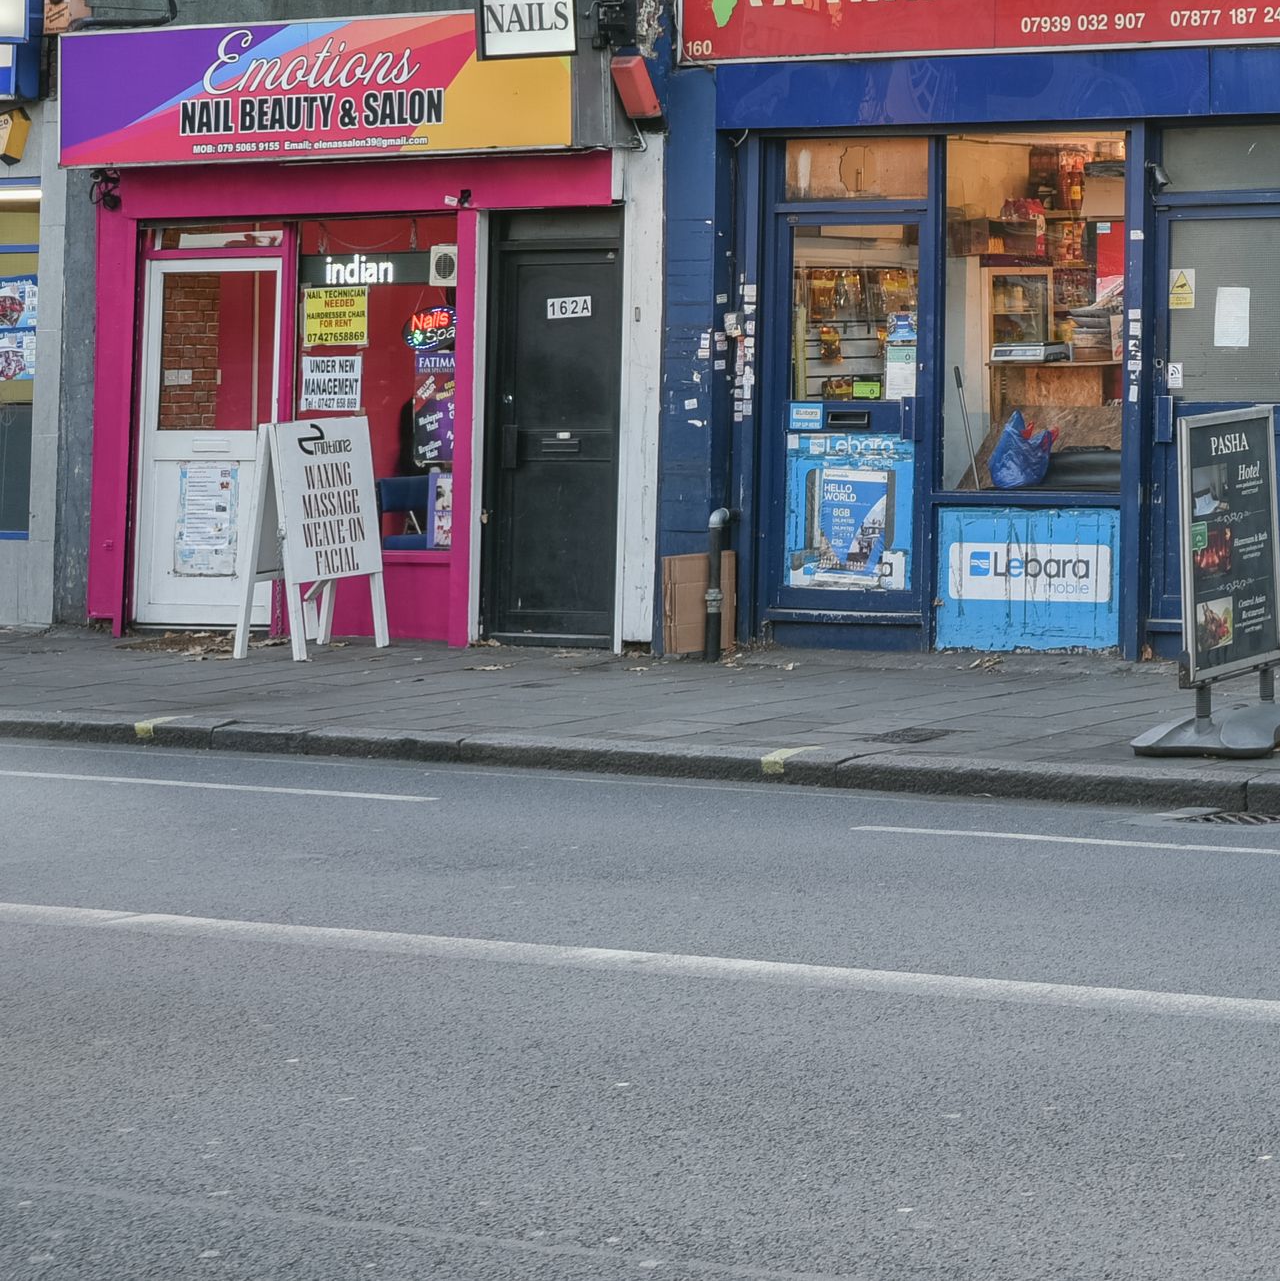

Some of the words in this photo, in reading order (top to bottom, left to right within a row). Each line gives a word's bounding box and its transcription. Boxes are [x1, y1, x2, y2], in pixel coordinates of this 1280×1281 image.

[484, 1, 570, 34] NAILS
[1020, 13, 1072, 33] 07939
[1077, 12, 1109, 32] 032
[1114, 12, 1146, 30] 907
[1170, 8, 1221, 28] 07877
[1228, 6, 1257, 26] 187
[686, 40, 713, 56] 160
[202, 29, 421, 95] Emotions
[180, 98, 234, 136] NAIL
[240, 92, 336, 133] BEAUTY
[339, 96, 359, 129] &
[364, 87, 445, 126] SALON
[193, 144, 216, 154] MOB:
[217, 143, 234, 153] 079
[235, 142, 257, 152] 5065
[258, 141, 280, 151] 9155
[325, 254, 394, 285] indian
[306, 290, 322, 300] NAIL
[324, 289, 366, 299] TECHNICIAN
[324, 299, 355, 308] NEEDED
[550, 300, 590, 316] 162A
[306, 311, 347, 319] HAIRDRESSER
[348, 310, 366, 319] CHAIR
[319, 319, 333, 328] FOR
[334, 318, 353, 328] RENT
[411, 311, 450, 331] Nails
[307, 331, 365, 343] 07427658869
[309, 359, 336, 373] UNDER
[338, 359, 356, 373] NEW
[419, 357, 456, 368] FATIMA
[304, 377, 359, 396] MANAGEMENT
[318, 398, 336, 409] 07427
[826, 436, 894, 456] Lebara
[1210, 432, 1250, 456] PASHA
[304, 461, 352, 490] WAXING
[1238, 461, 1260, 480] Hotel
[824, 483, 853, 493] HELLO
[302, 488, 361, 519] MASSAGE
[824, 492, 857, 502] WORLD
[832, 507, 851, 517] 8GB
[302, 517, 366, 548] WEAVE-ON
[315, 546, 359, 576] FACIAL
[993, 551, 1090, 580] Lebara
[1043, 581, 1089, 595] mobile
